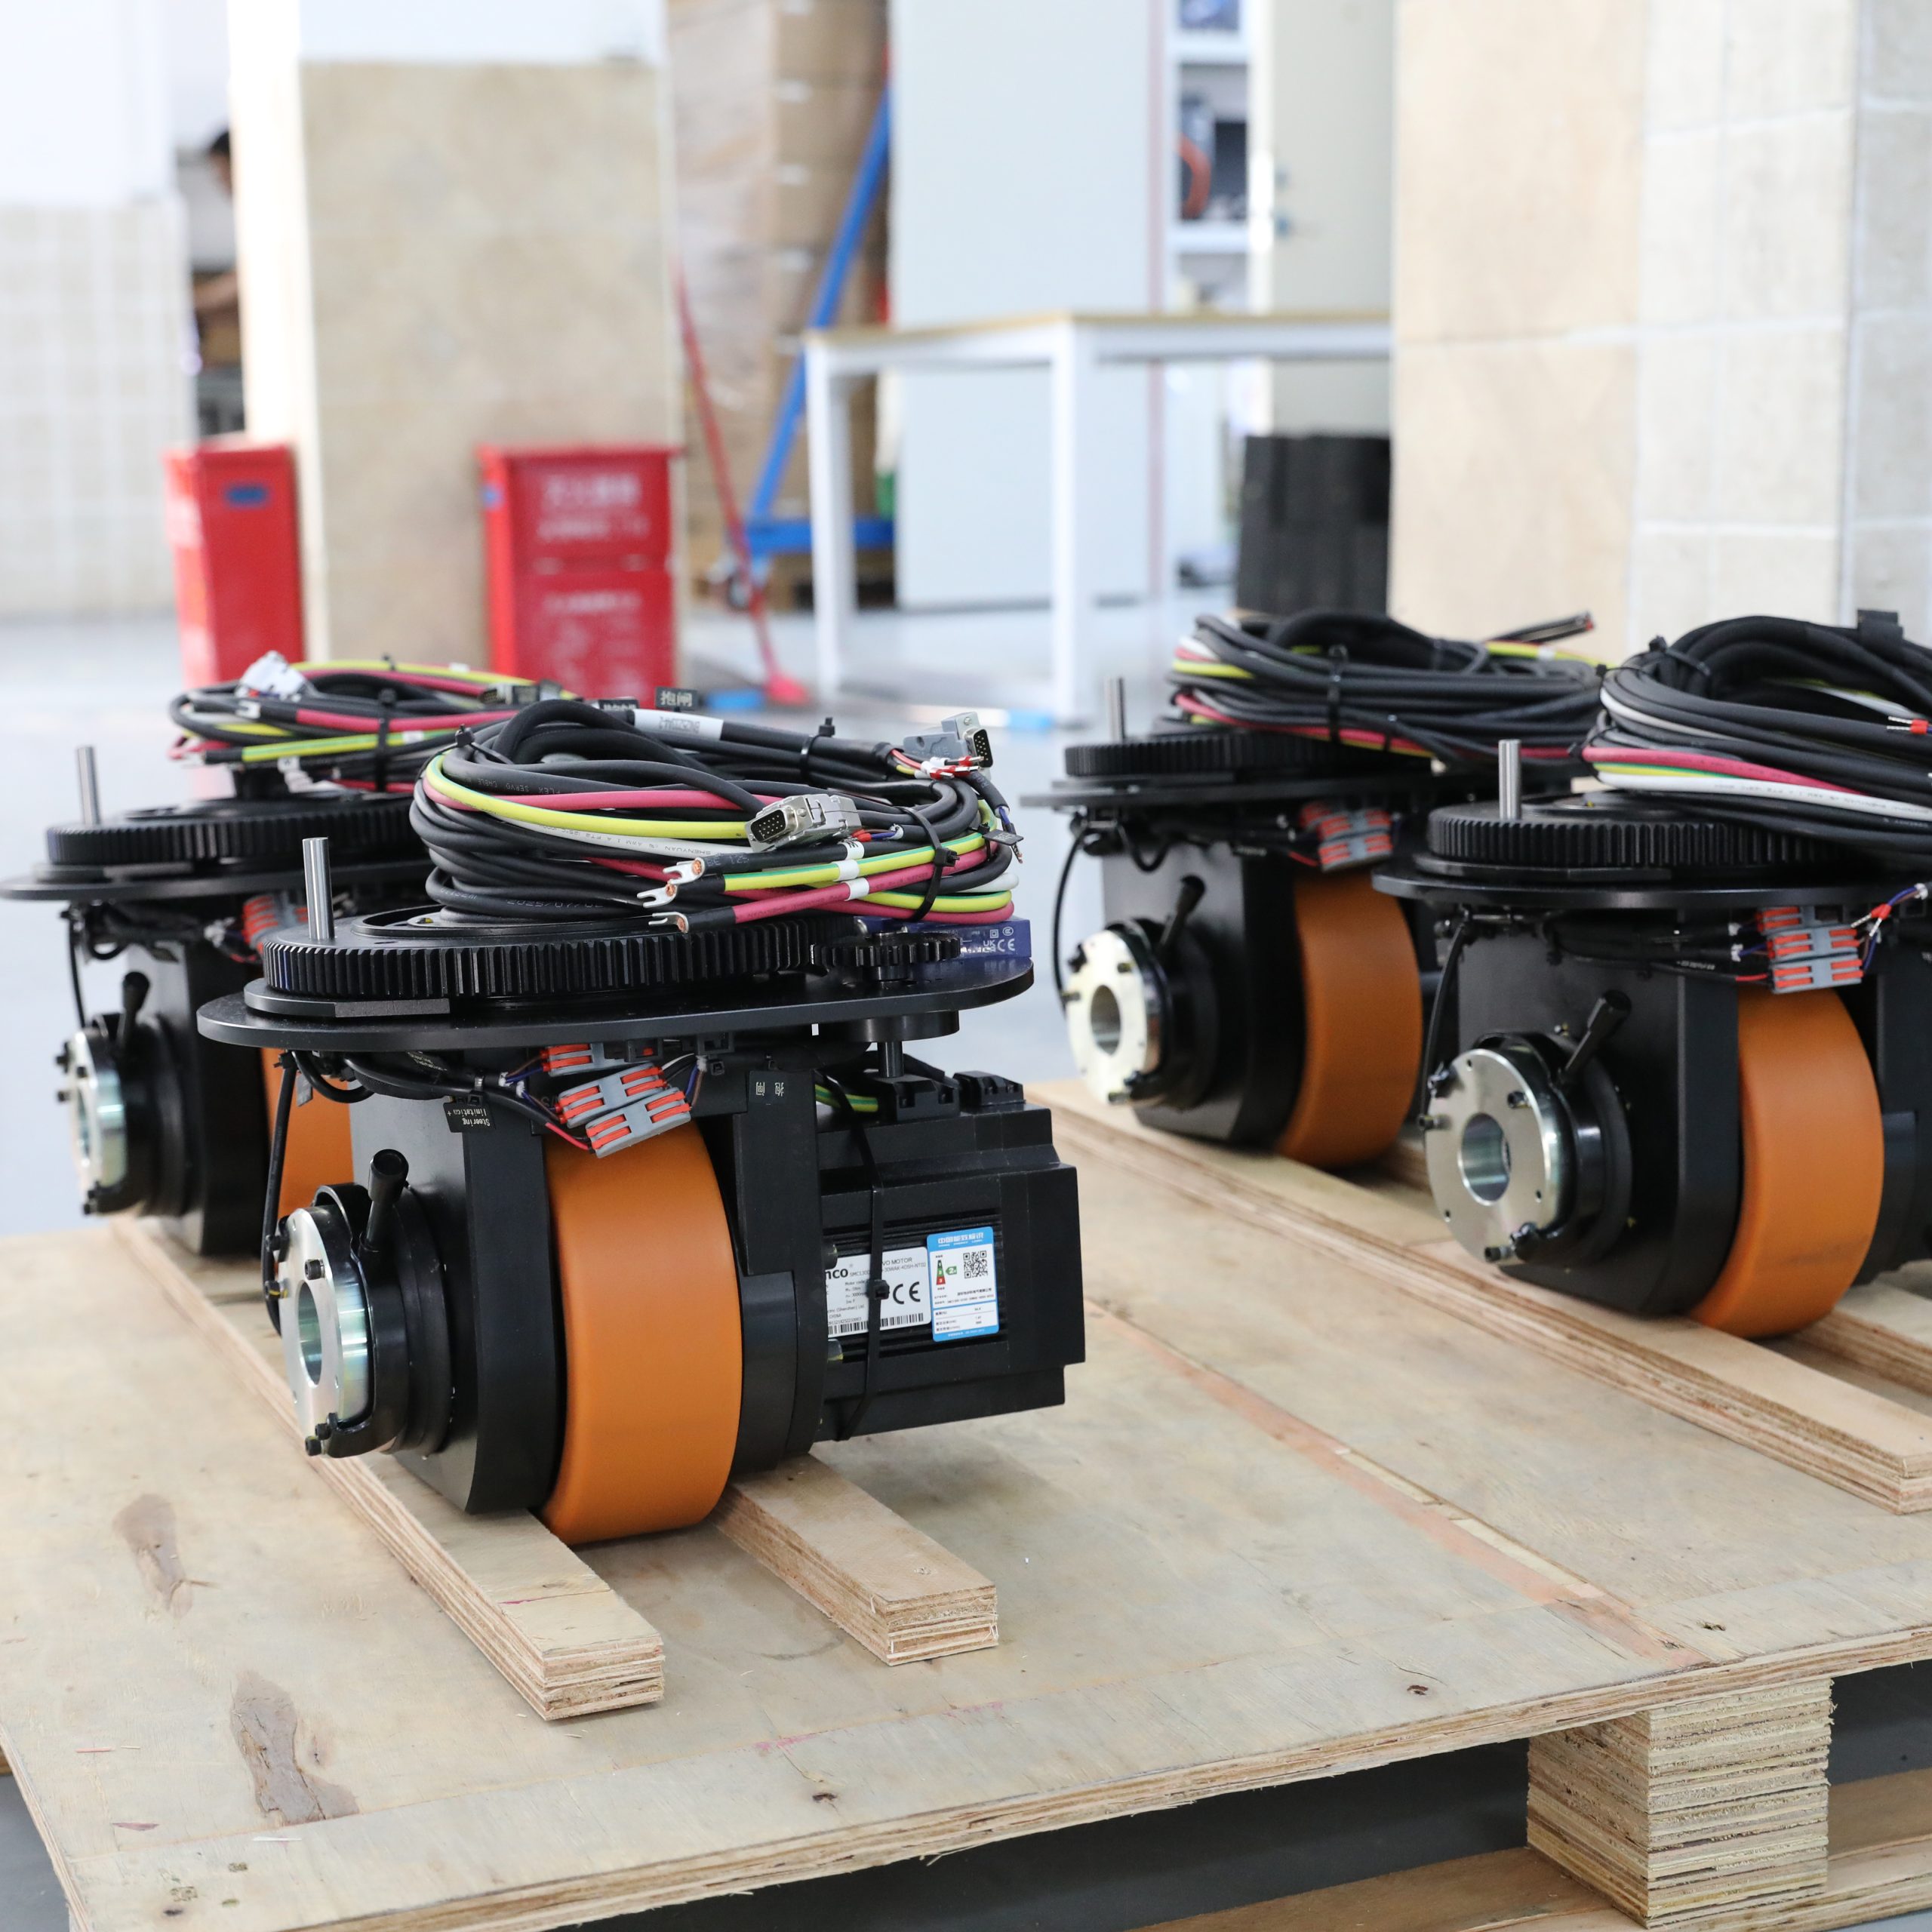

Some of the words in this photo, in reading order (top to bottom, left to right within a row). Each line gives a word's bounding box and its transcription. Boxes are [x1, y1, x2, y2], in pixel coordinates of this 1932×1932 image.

[665, 846, 711, 855] SHENYUAN
[997, 938, 1016, 952] CE
[462, 1118, 491, 1127] Steering
[891, 1257, 912, 1265] MOTOR
[893, 1281, 921, 1304] CE
